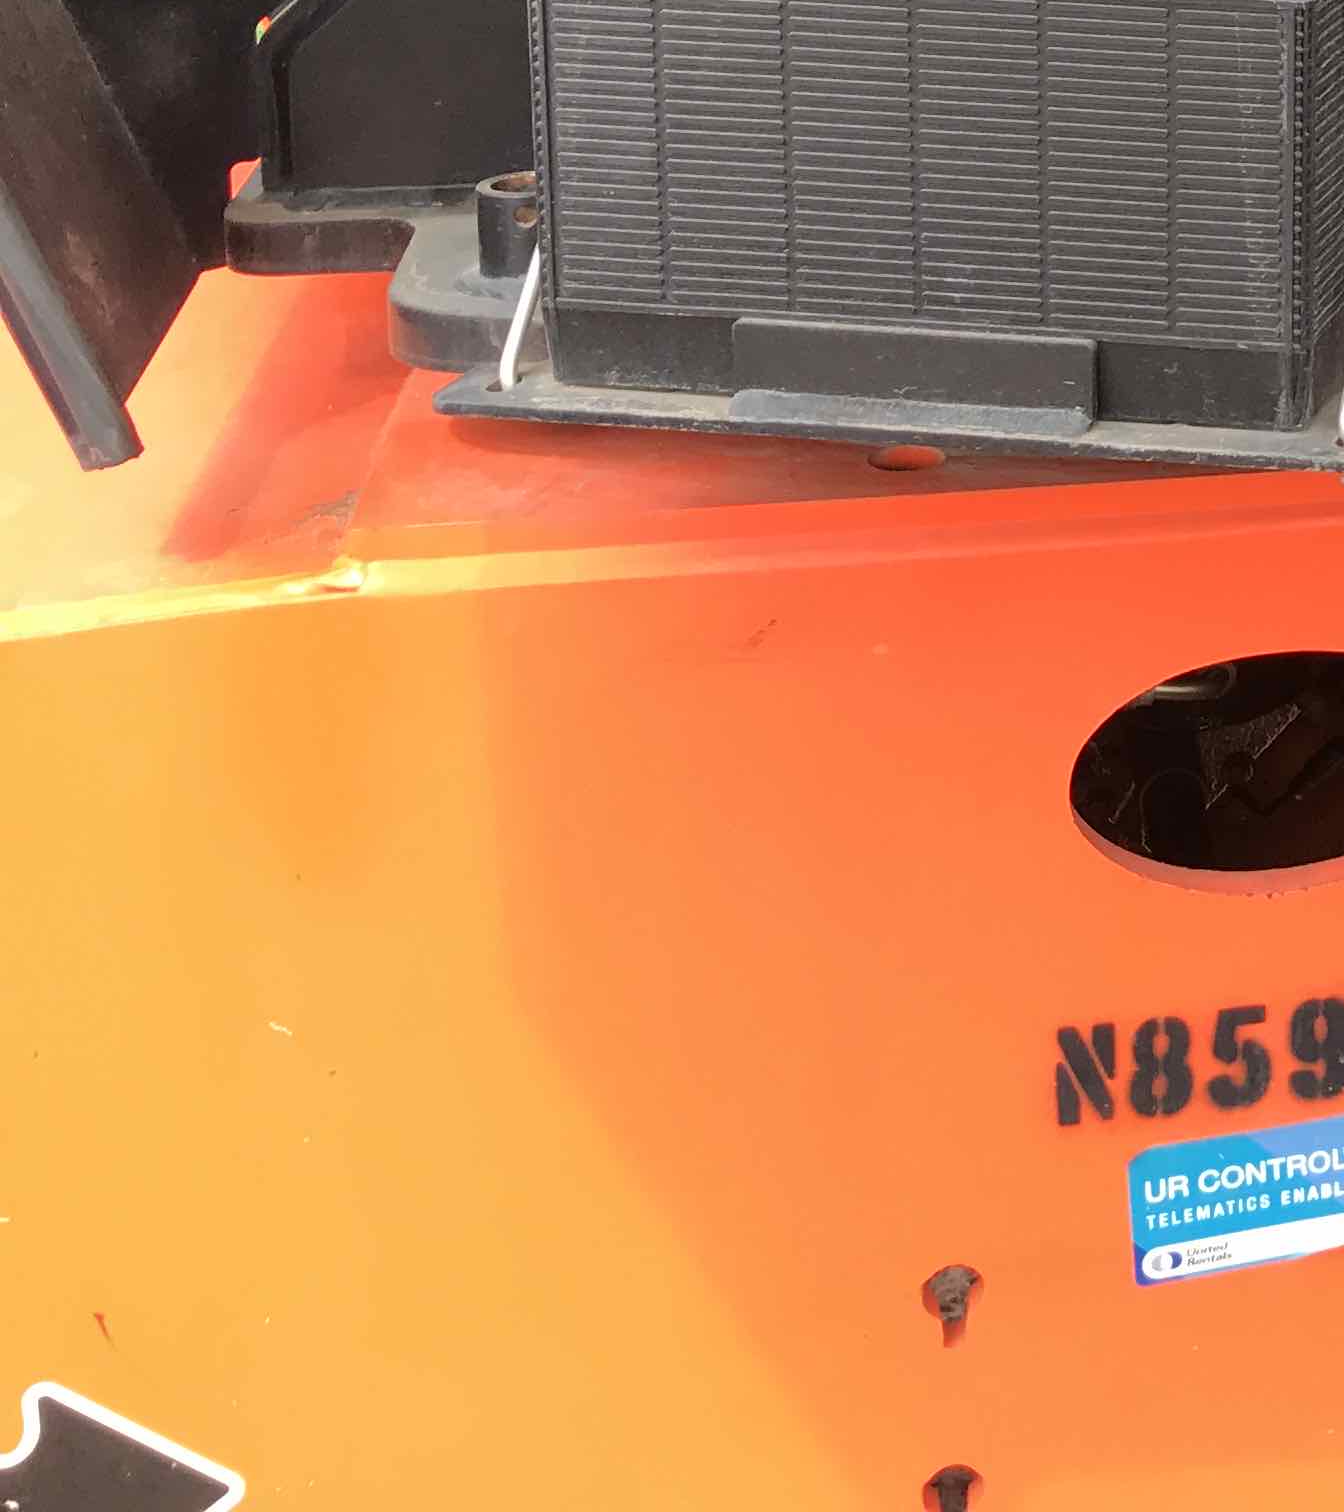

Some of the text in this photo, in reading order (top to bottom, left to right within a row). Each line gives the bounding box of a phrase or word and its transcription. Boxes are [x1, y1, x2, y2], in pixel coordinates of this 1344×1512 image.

[1144, 1174, 1190, 1204] UR
[1146, 1193, 1271, 1231] TELEMATICS
[1186, 1242, 1229, 1258] United
[1186, 1251, 1233, 1267] Rentals
